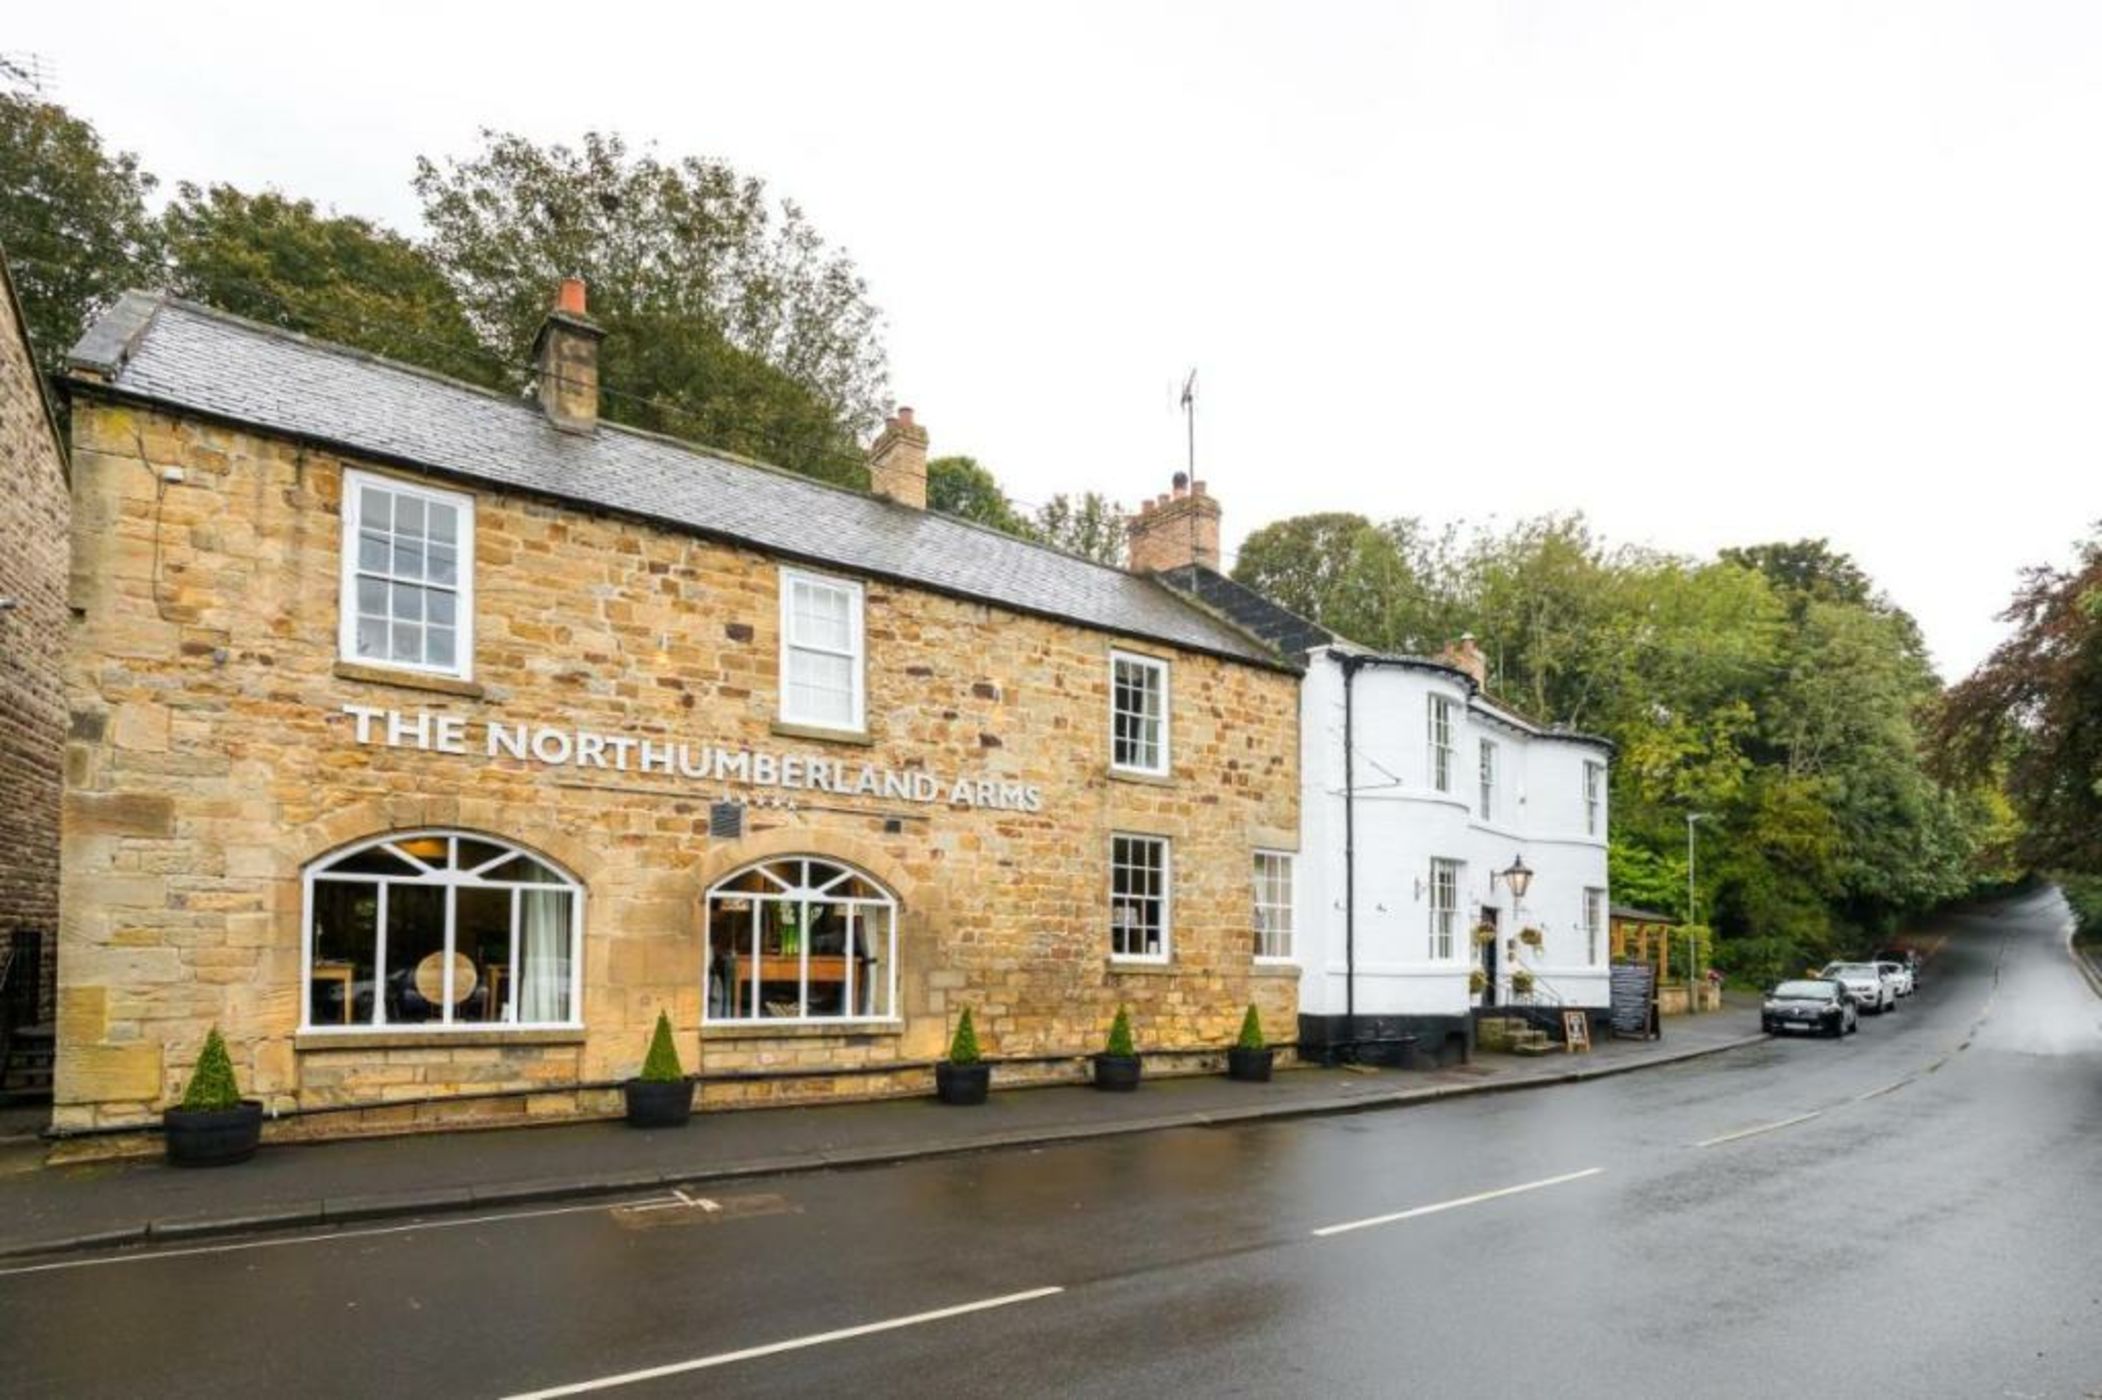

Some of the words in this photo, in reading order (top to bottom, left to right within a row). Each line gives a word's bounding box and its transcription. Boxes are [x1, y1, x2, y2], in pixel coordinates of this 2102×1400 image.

[342, 702, 467, 755] THE
[487, 722, 938, 802] NORTHUMBERLAND
[950, 777, 1042, 812] ARMS
